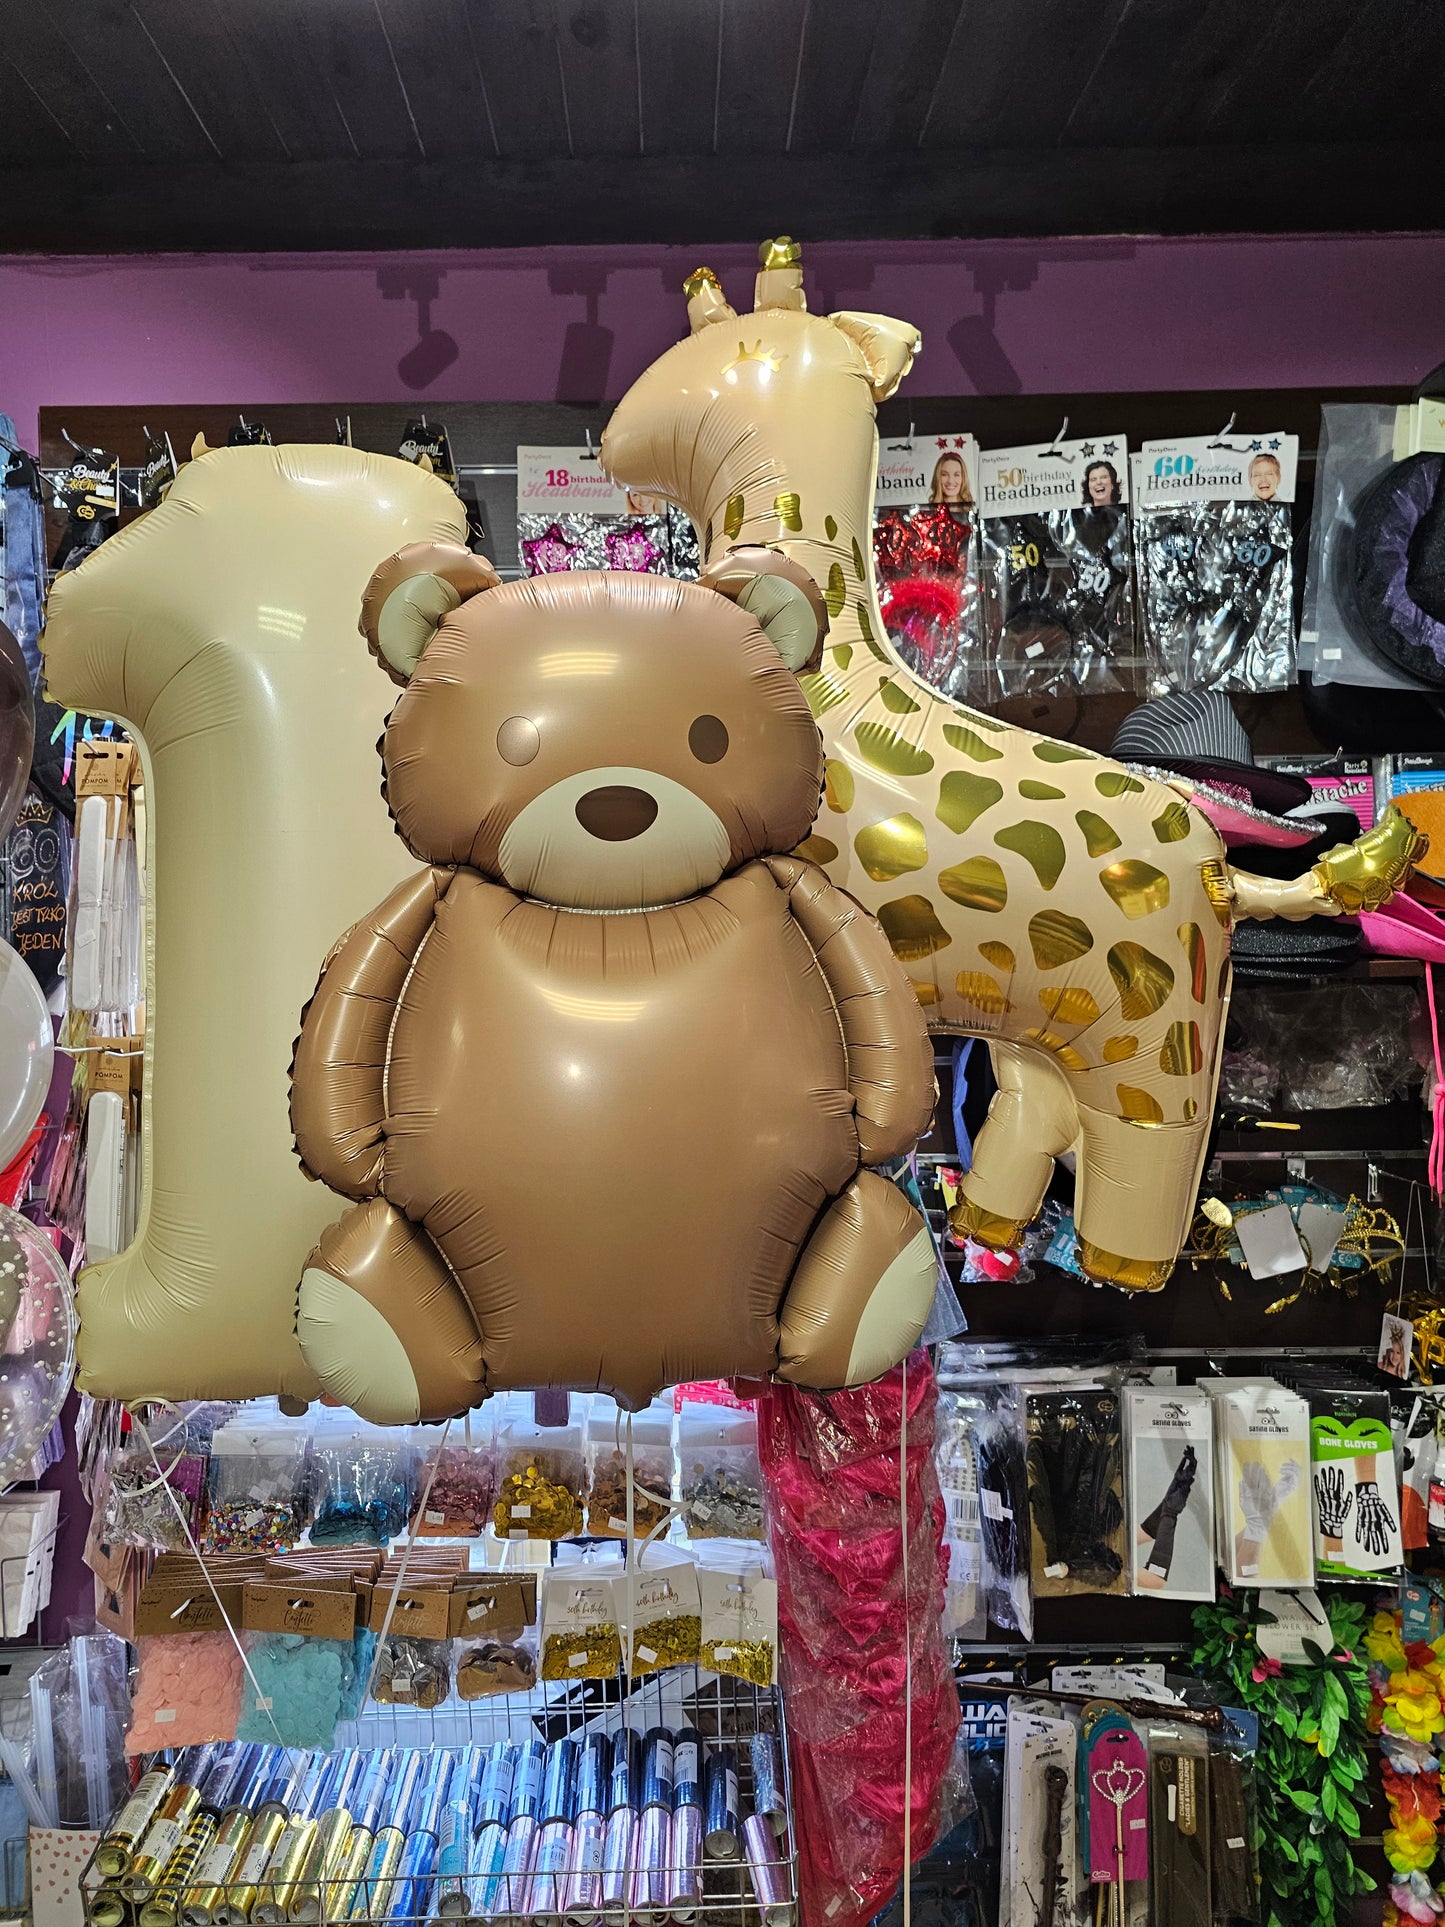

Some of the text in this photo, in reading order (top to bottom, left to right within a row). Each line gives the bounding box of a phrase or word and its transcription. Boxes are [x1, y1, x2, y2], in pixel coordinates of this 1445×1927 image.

[72, 464, 114, 483] Beauty
[545, 469, 569, 487] 18
[1023, 469, 1072, 484] birthday
[1146, 472, 1243, 491] Headband
[522, 481, 615, 498] Headband
[984, 480, 1077, 502] Headband
[1010, 542, 1040, 570] 50
[1236, 539, 1271, 567] 60
[1077, 564, 1112, 594] 50
[10, 827, 60, 874] 60
[16, 927, 64, 957] JEDEN
[95, 1071, 123, 1079] POMPOM
[1319, 1436, 1378, 1449] BONE GLOVES
